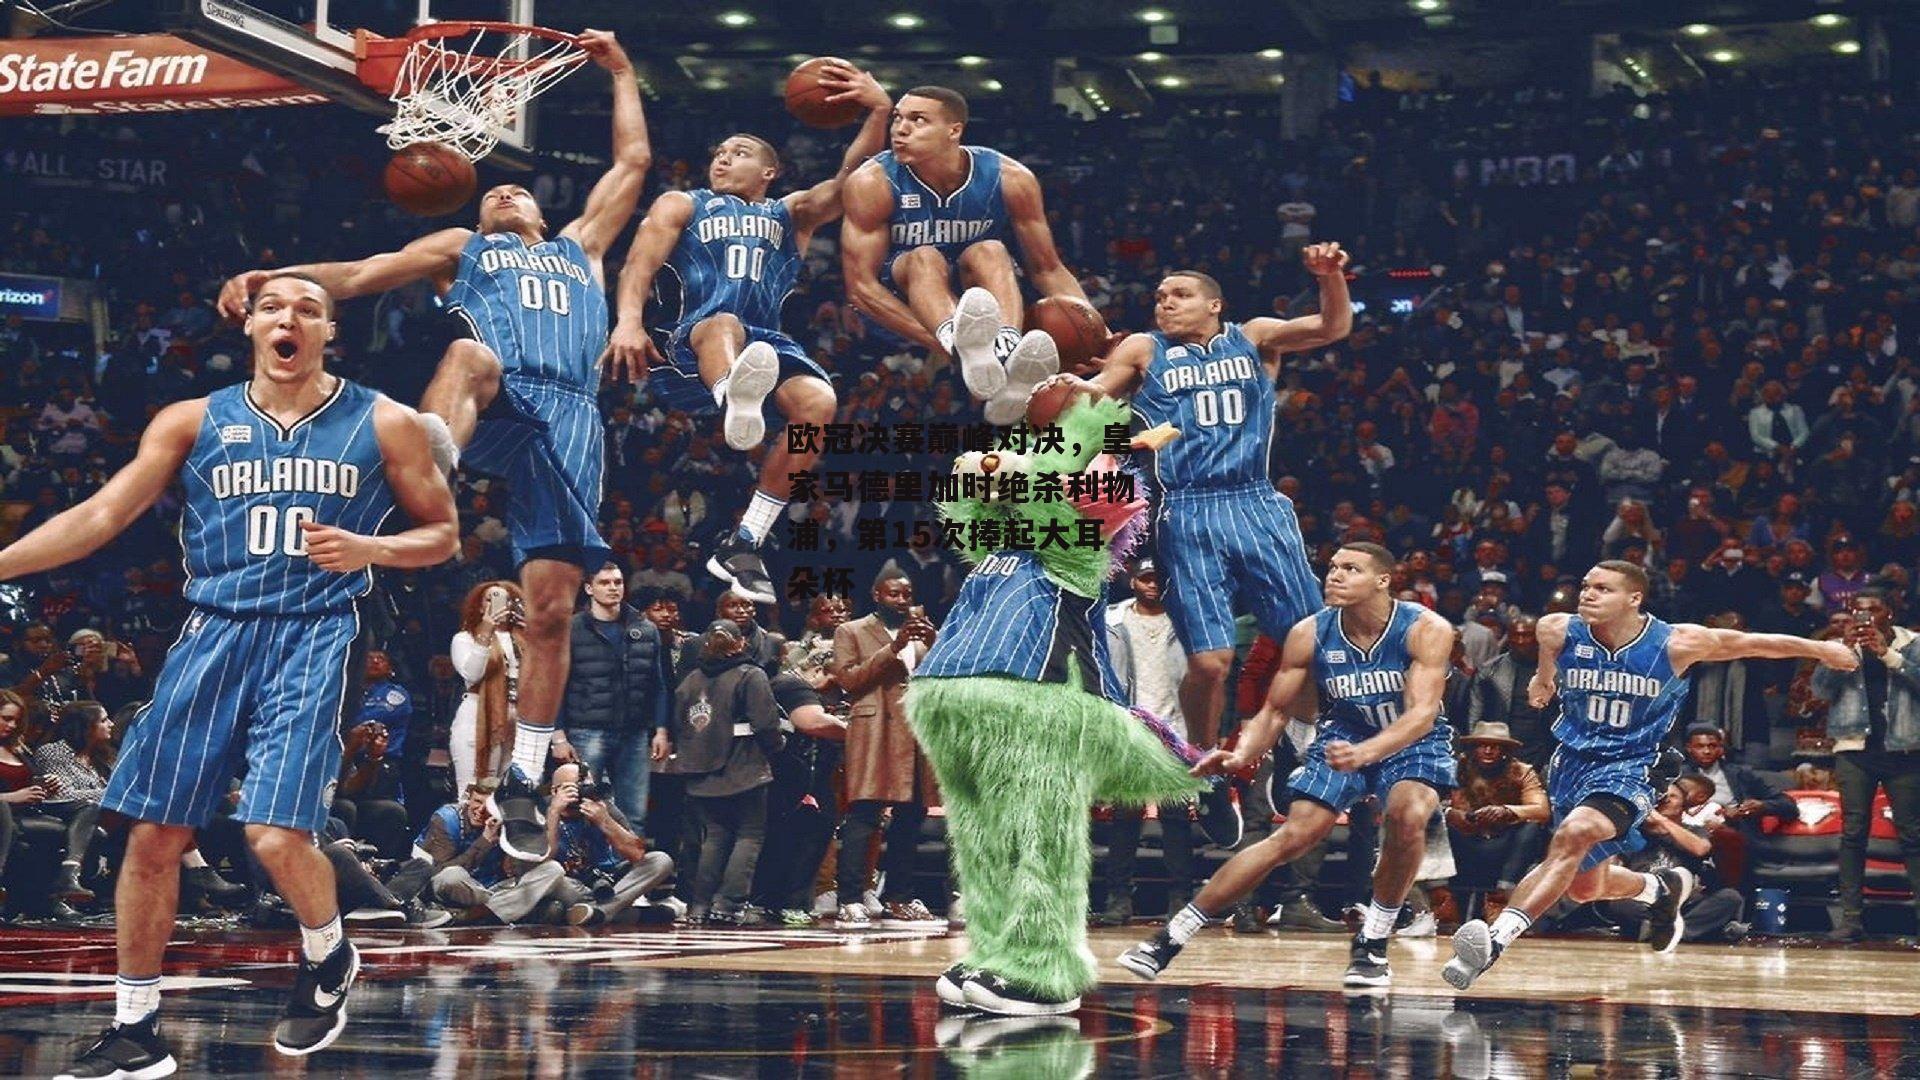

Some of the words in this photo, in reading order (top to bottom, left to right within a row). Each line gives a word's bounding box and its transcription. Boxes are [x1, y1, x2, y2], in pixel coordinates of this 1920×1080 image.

[0, 53, 100, 93] State
[100, 50, 208, 88] Farm
[22, 150, 72, 176] ALL
[98, 157, 168, 187] STAR
[727, 243, 766, 283] 00
[518, 273, 570, 316] 00
[1194, 387, 1246, 427] 00
[211, 457, 360, 500] ORLANDO
[249, 504, 315, 557] 00
[1325, 669, 1406, 699] ORLAND
[1566, 667, 1662, 699] ORLANDO
[1588, 694, 1631, 729] 00
